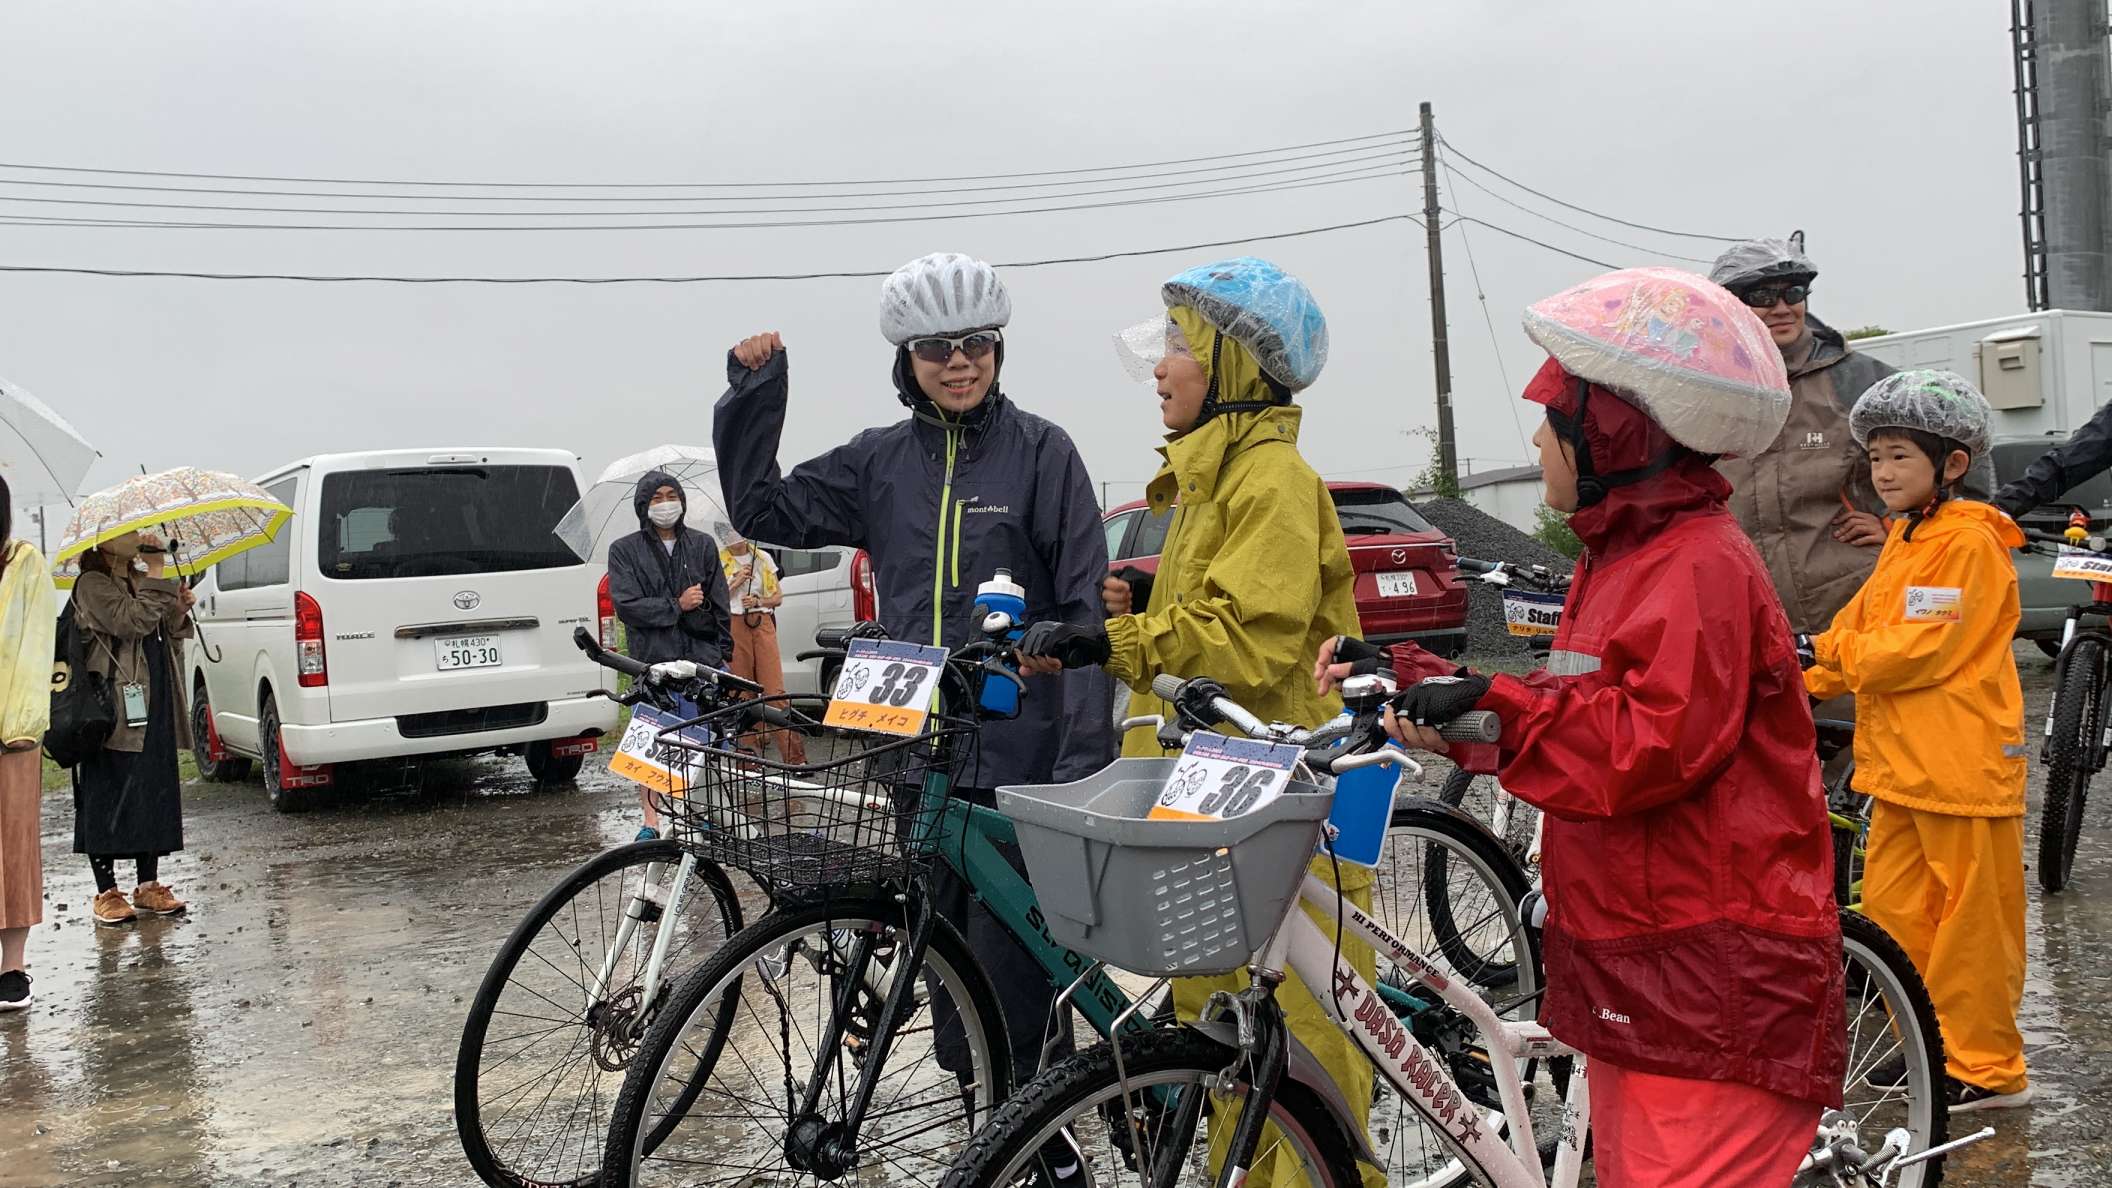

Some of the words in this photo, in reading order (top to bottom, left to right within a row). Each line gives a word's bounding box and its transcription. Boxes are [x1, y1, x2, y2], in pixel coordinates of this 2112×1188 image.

[451, 647, 498, 666] 50-30
[868, 662, 929, 708] 33
[555, 742, 594, 756] TRD
[286, 774, 329, 787] TRD
[1197, 765, 1276, 818] 36
[1351, 911, 1367, 925] HI
[1365, 920, 1440, 978] PERFORMANCE
